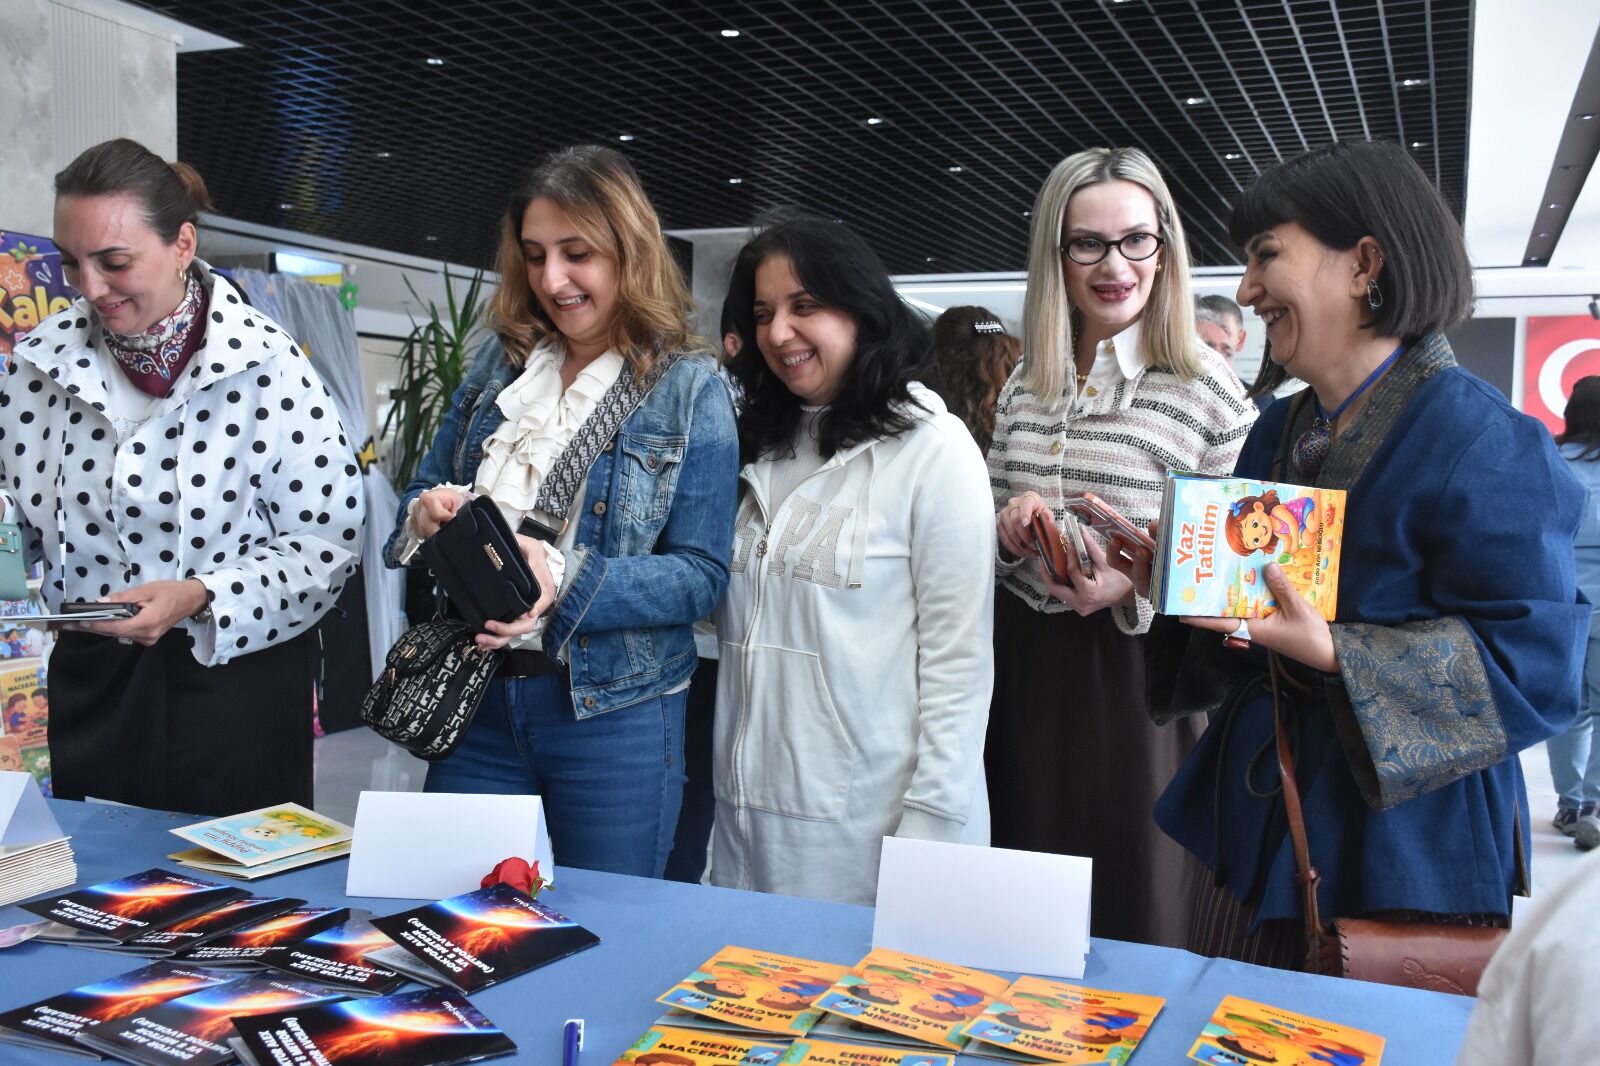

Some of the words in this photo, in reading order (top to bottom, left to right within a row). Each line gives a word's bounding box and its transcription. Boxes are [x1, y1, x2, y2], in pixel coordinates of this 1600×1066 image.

[1176, 522, 1195, 566] Yaz
[1196, 504, 1218, 584] Tatilim
[400, 931, 426, 946] ALEX
[412, 930, 449, 954] METEOR
[290, 962, 320, 972] ALEX
[300, 960, 345, 972] METEOR
[423, 946, 464, 972] DOKTOR
[455, 958, 470, 968] VE
[320, 970, 368, 982] DOKTOR
[706, 1004, 764, 1022] ERENİN
[862, 1011, 919, 1030] ERENİN
[119, 1030, 151, 1043] ALEX
[258, 1030, 280, 1048] ALEX
[146, 1041, 195, 1060] DOKTOR
[658, 1043, 770, 1065] MACERALARI
[690, 1040, 750, 1054] ERENİN
[1013, 1038, 1074, 1056] ERENİN
[840, 1052, 902, 1064] ERENİN
